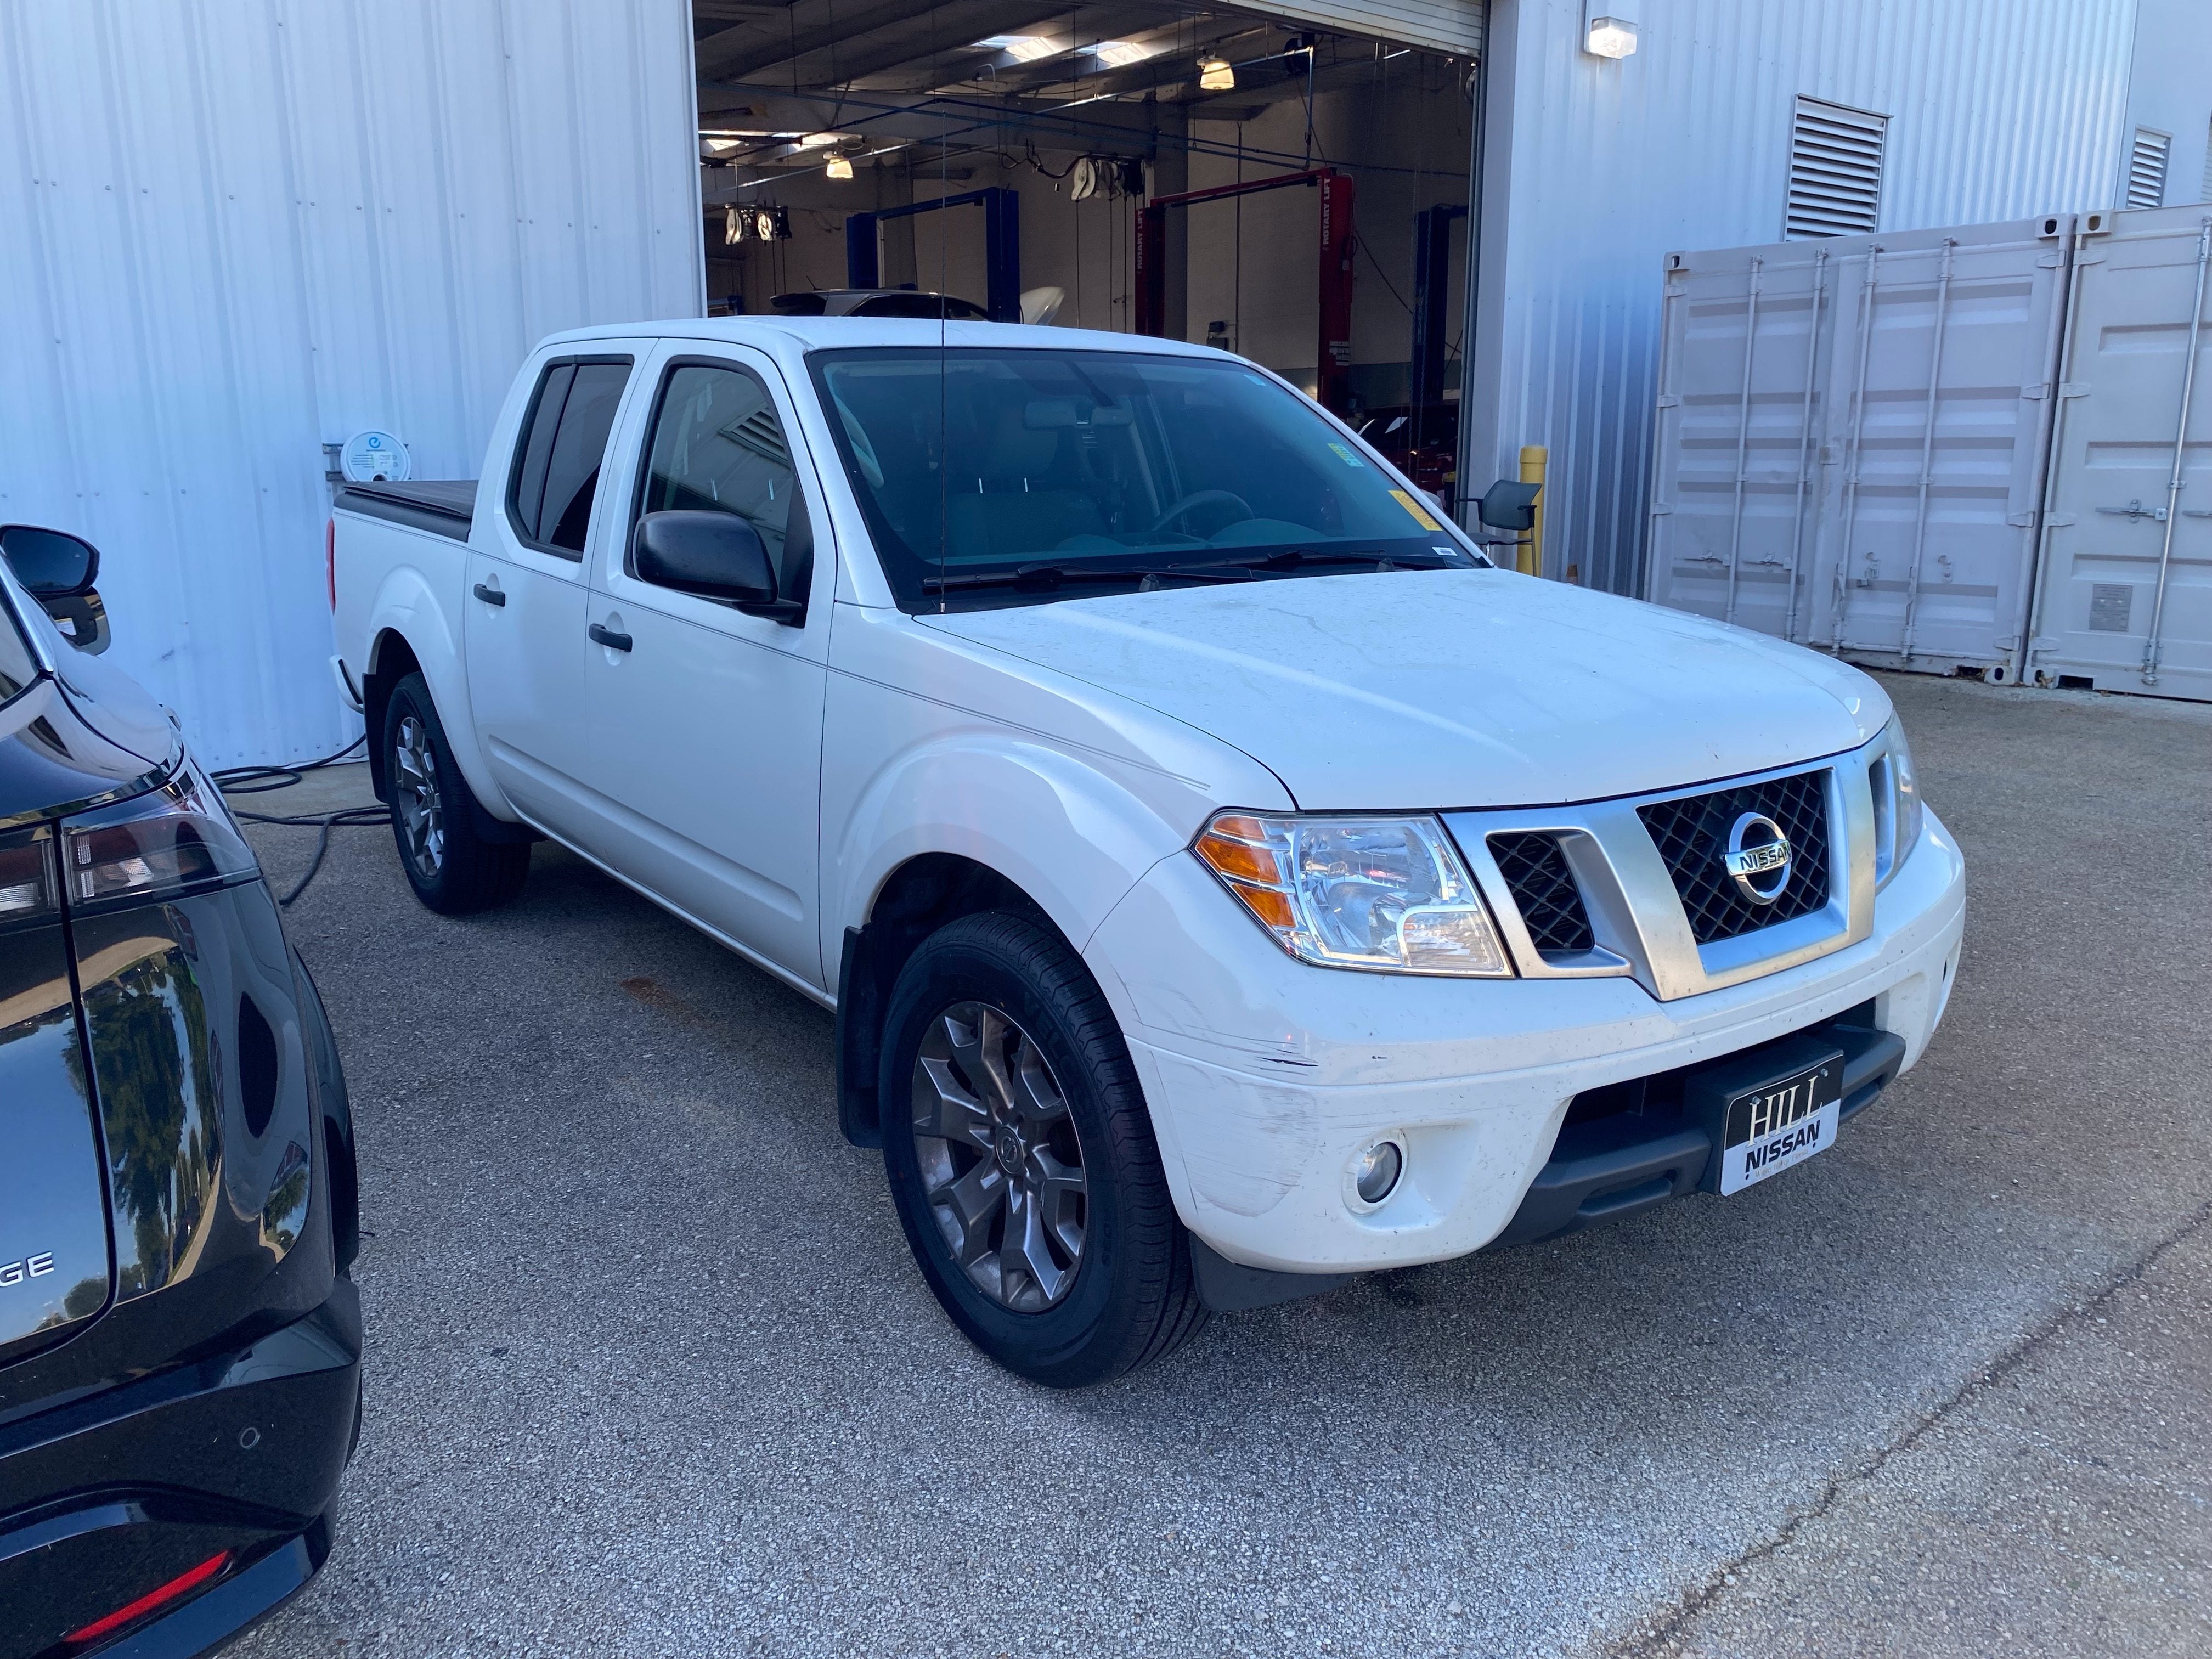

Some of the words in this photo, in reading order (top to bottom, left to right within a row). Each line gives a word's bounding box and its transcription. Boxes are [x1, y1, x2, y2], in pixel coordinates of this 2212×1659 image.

[1739, 846, 1791, 870] NISSAN
[1746, 1075, 1823, 1148] HILL
[1745, 1119, 1821, 1173] NISSAN
